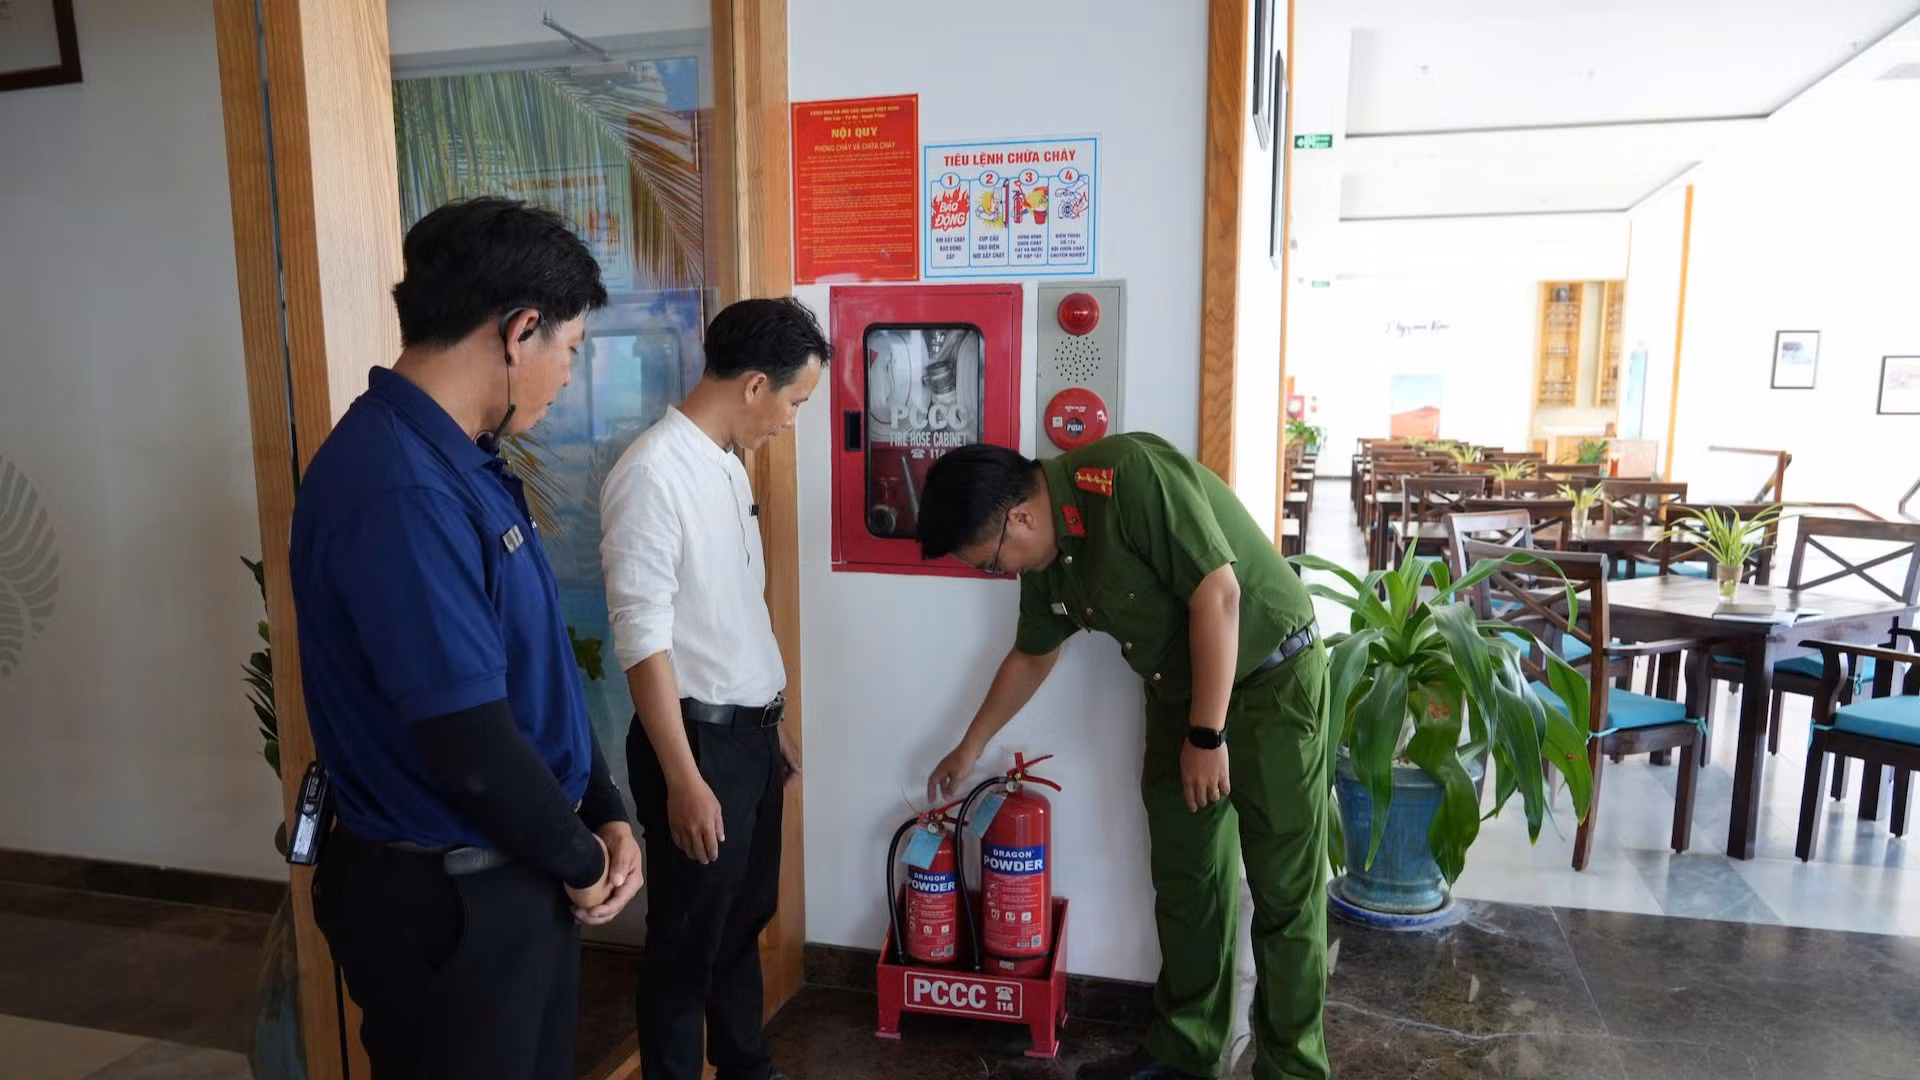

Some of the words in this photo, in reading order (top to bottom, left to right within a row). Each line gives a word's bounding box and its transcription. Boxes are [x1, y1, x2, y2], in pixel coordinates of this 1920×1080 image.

[831, 127, 851, 140] NỘI
[855, 126, 878, 138] QUY
[944, 153, 969, 166] TIÊU
[973, 152, 1004, 167] LỆNH
[1007, 149, 1040, 164] CHỮA
[1044, 148, 1076, 162] CHÁY
[947, 176, 953, 185] 1
[986, 174, 993, 184] 2
[1025, 172, 1033, 182] 3
[1065, 171, 1073, 181] 4
[935, 212, 965, 230] ĐỘNG
[891, 405, 967, 430] PCCC
[890, 432, 908, 447] FIRE
[910, 432, 931, 447] HOSE
[933, 432, 968, 447] CABINET
[993, 849, 1032, 858] DRAGON
[984, 855, 1043, 871] POWDER
[914, 872, 946, 881] DRAGON
[913, 978, 986, 1008] PCCC
[996, 1002, 1014, 1012] 114
